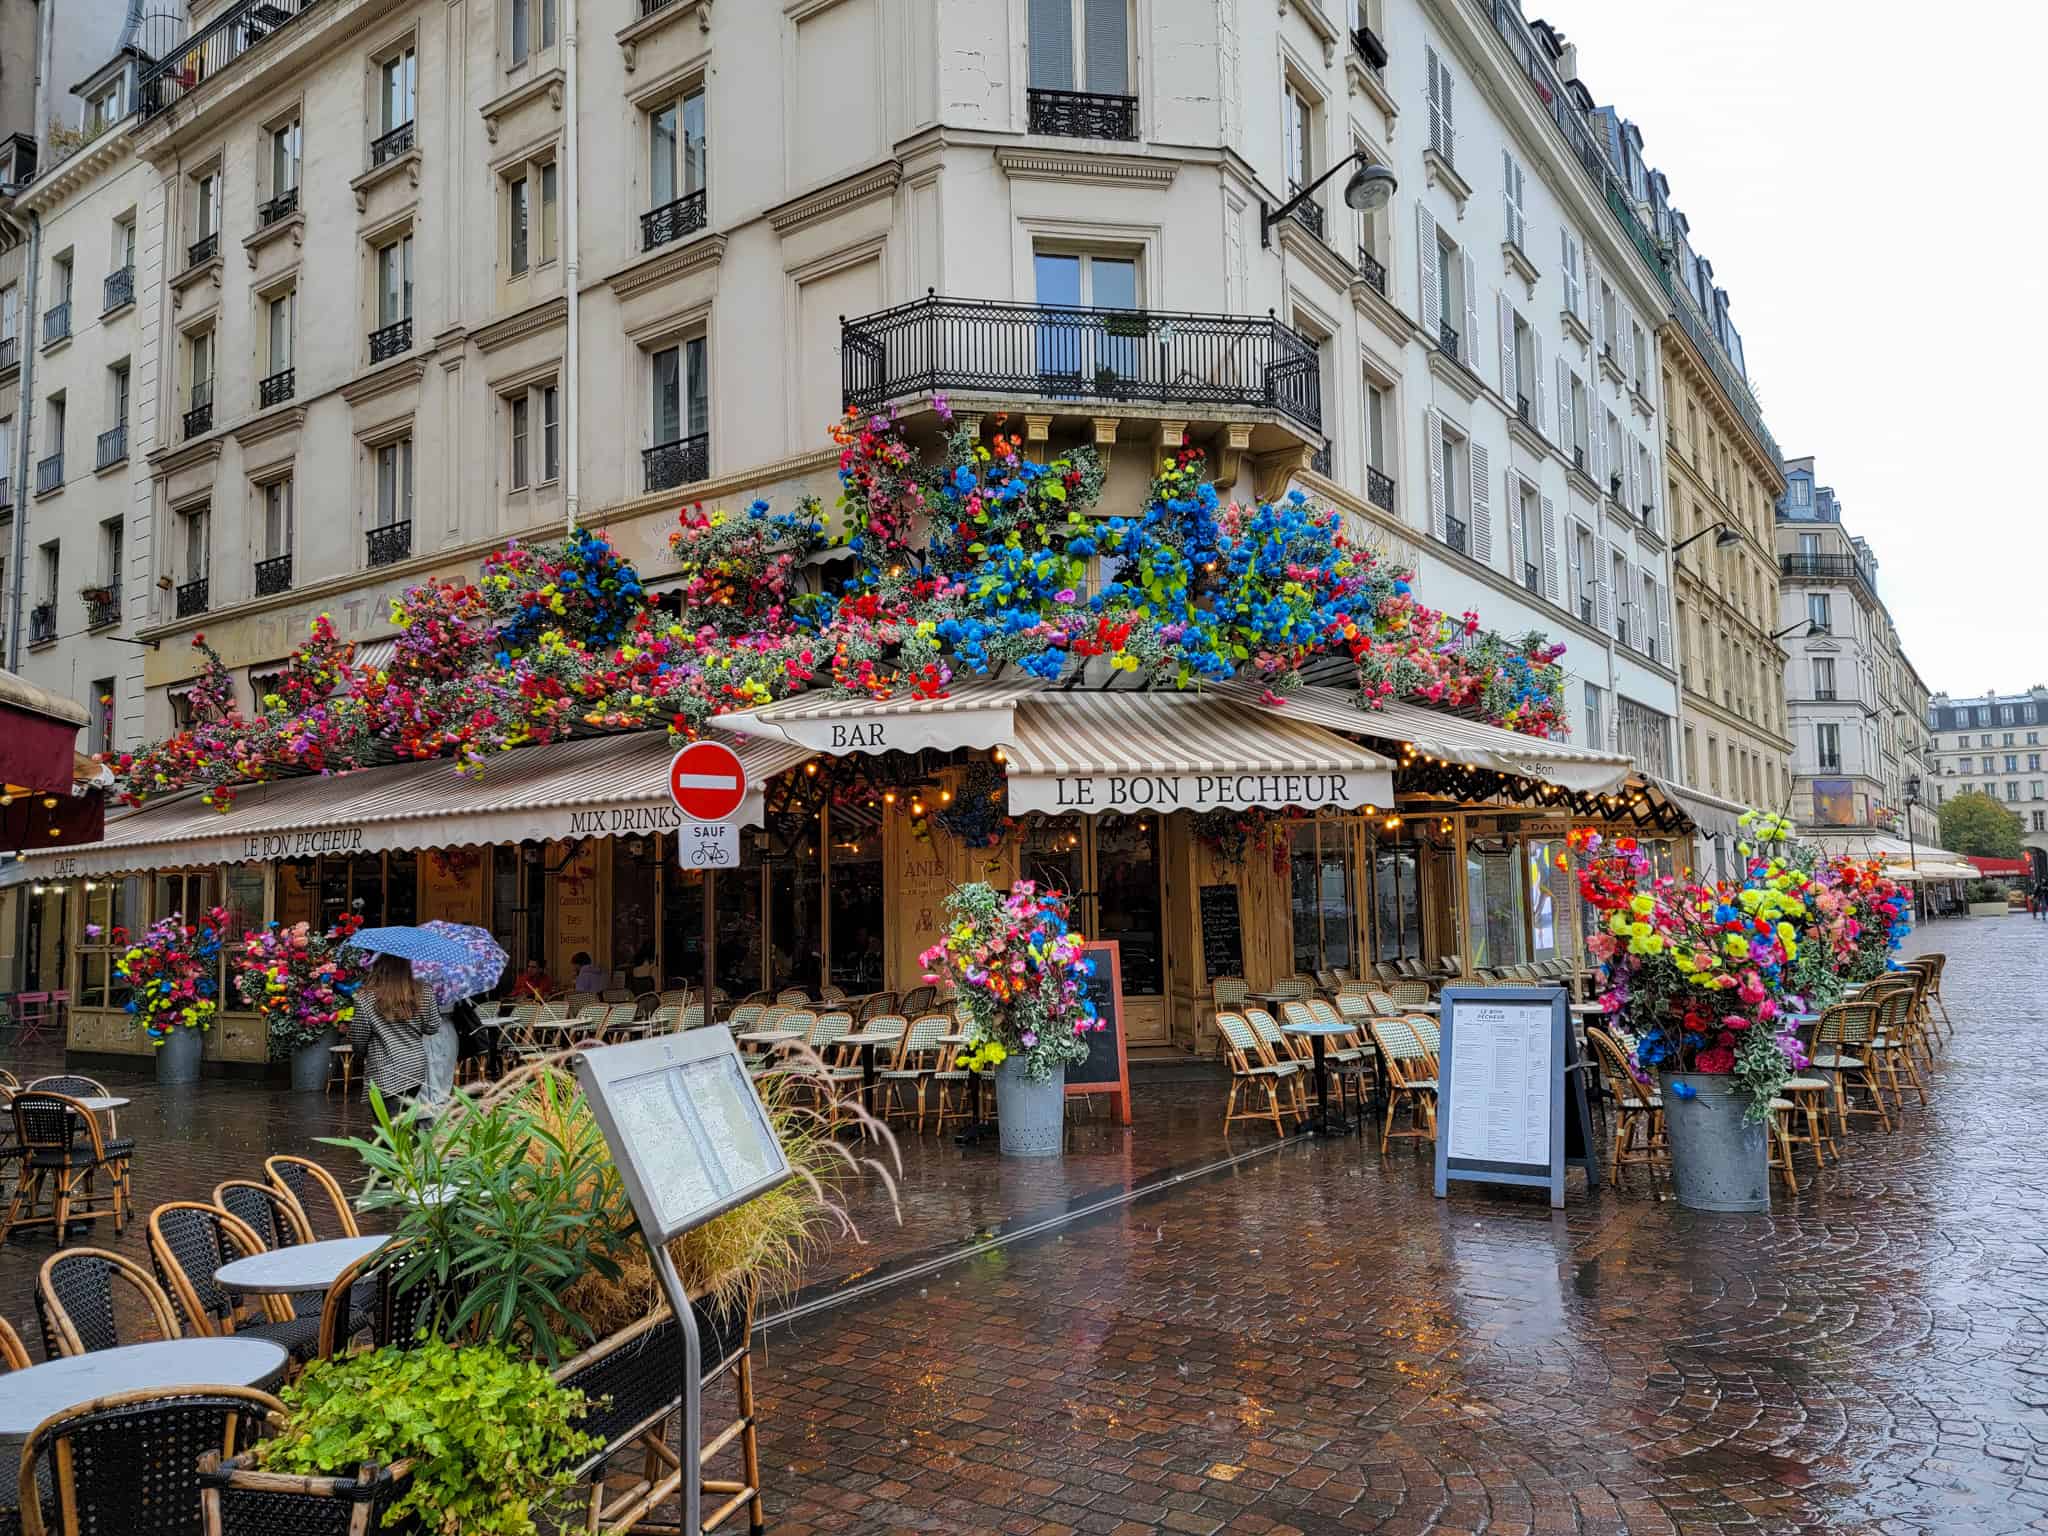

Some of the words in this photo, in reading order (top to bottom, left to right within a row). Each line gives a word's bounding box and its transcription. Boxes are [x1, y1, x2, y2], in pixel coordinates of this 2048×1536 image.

[831, 723, 886, 747] BAR
[1535, 762, 1554, 775] Bon
[1055, 777, 1095, 806] LE
[1109, 776, 1181, 805] BON
[1195, 774, 1350, 803] PECHEUR
[570, 810, 606, 833] MIX
[612, 806, 681, 831] DRINKS
[694, 826, 726, 838] SAUF
[243, 837, 258, 858] LE
[263, 833, 290, 856] BON
[296, 828, 363, 854] PECHEUR
